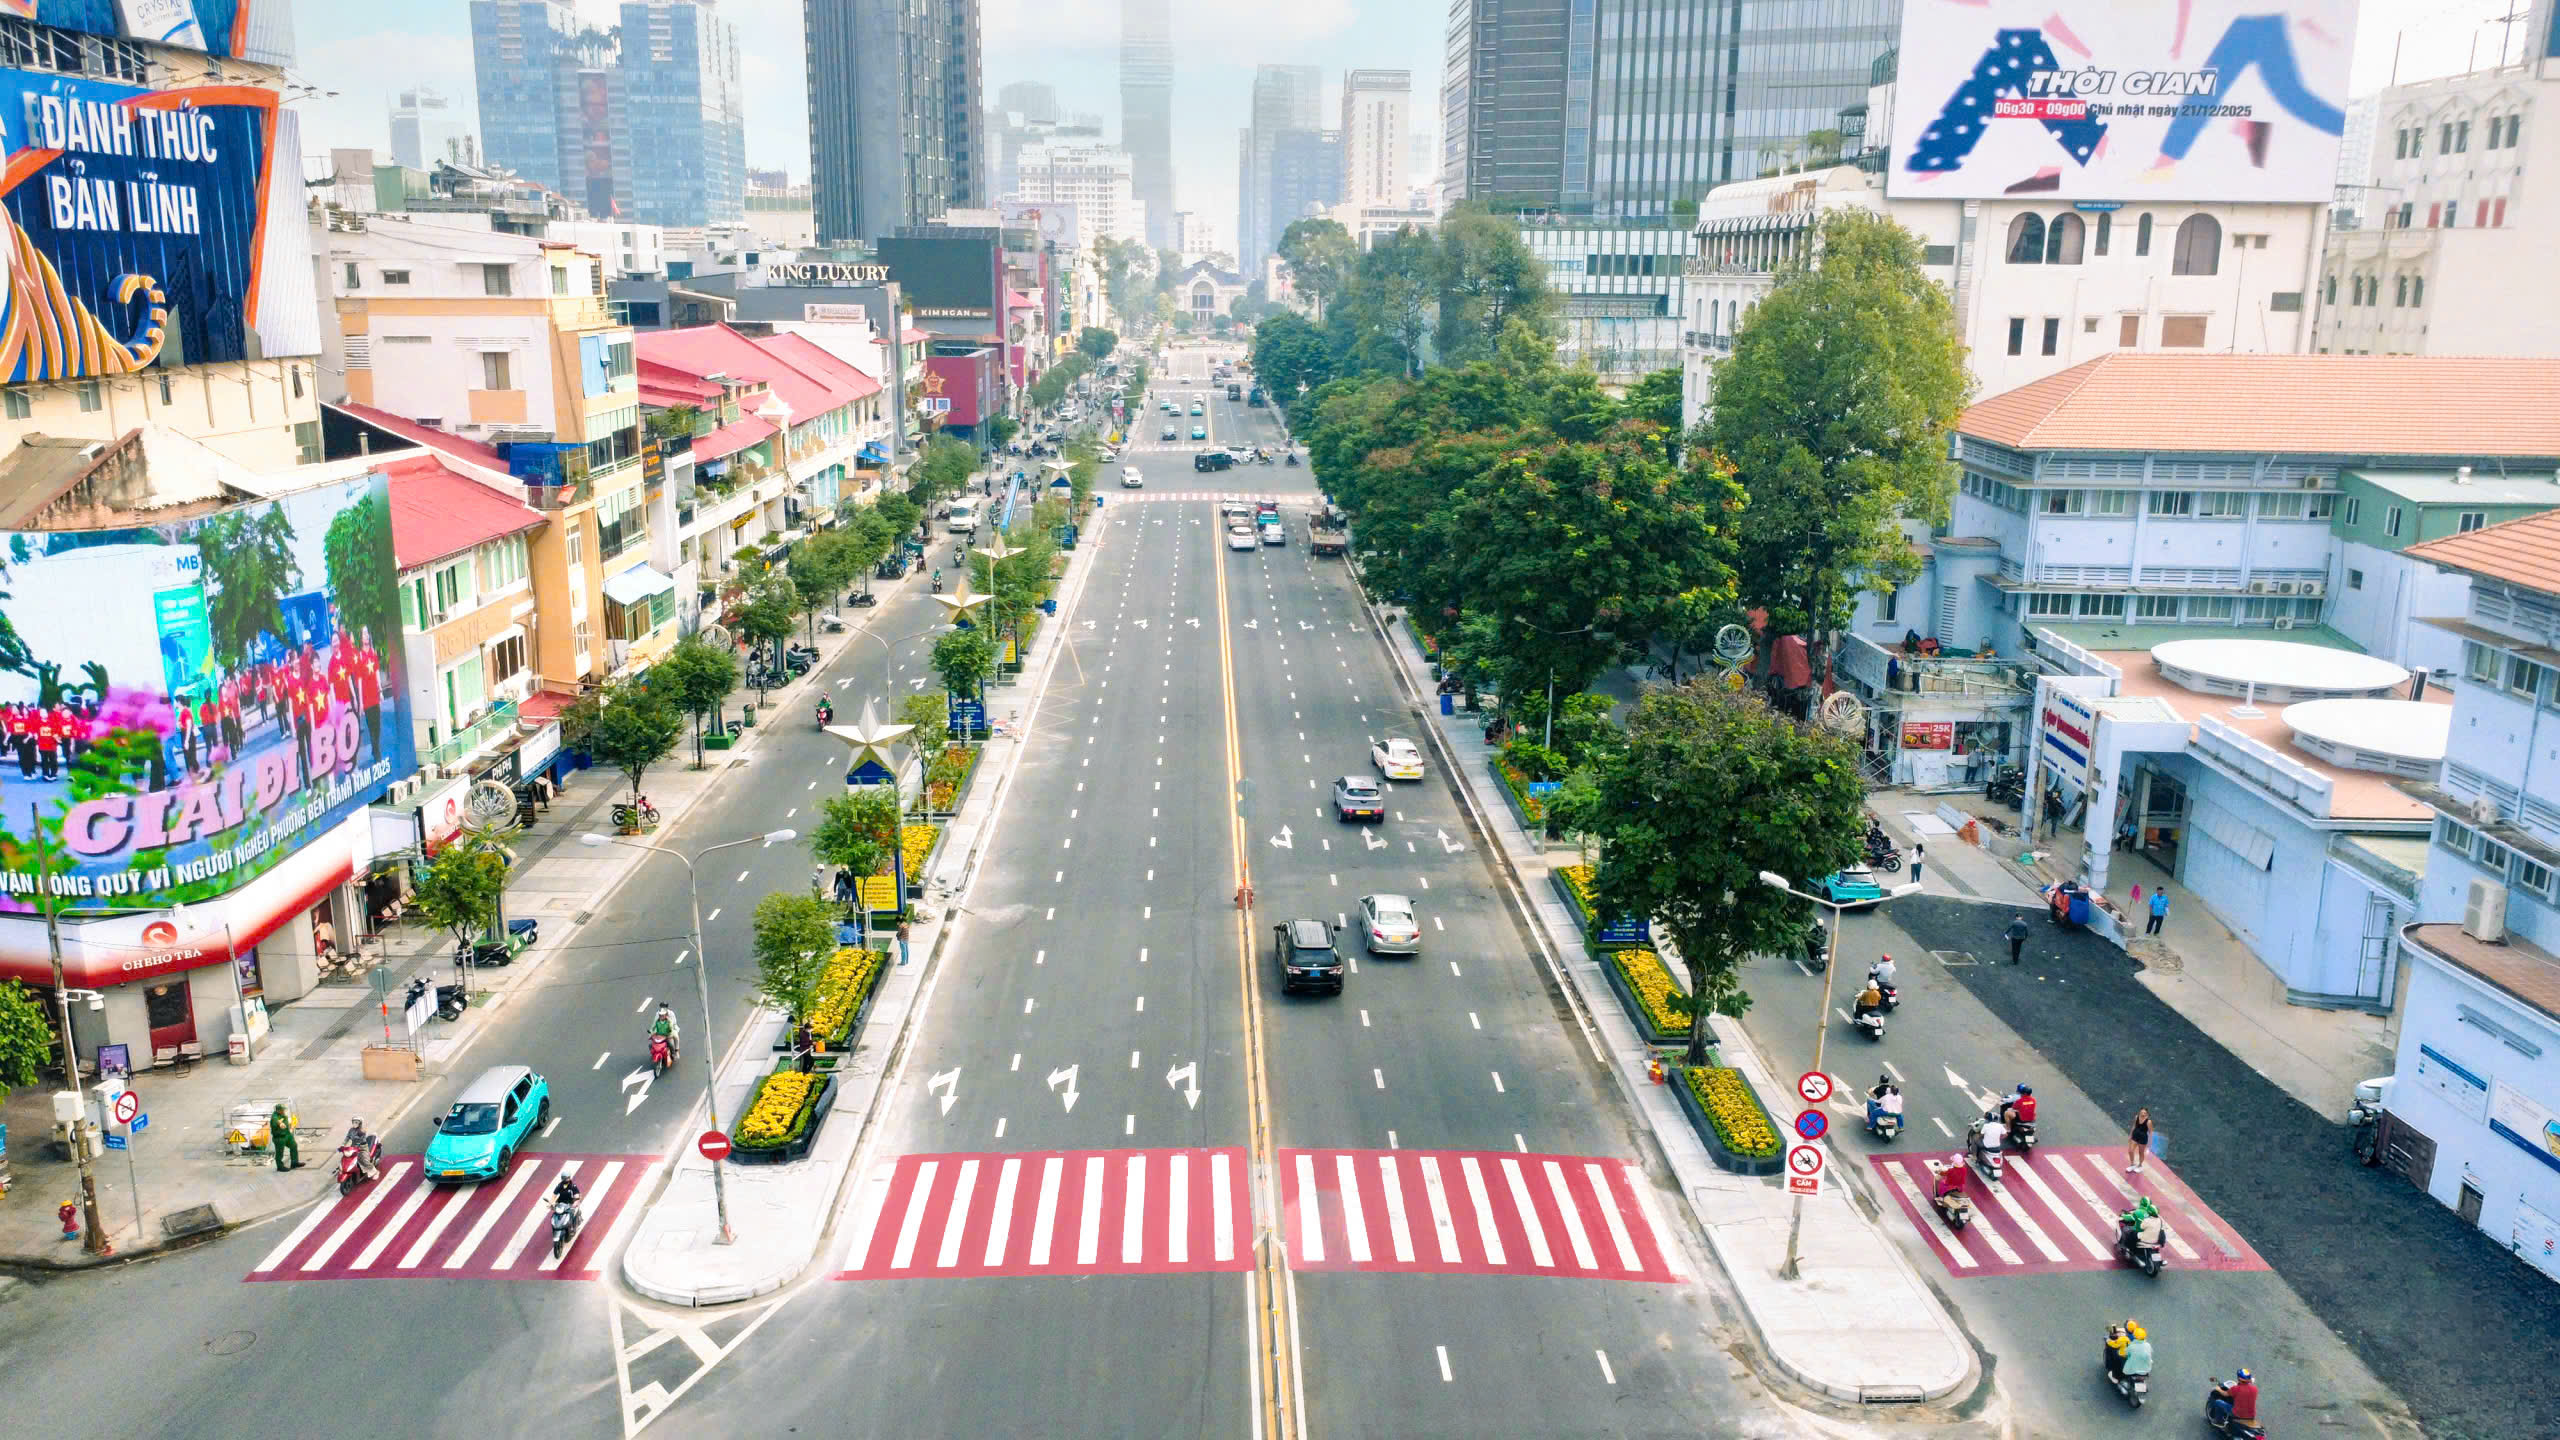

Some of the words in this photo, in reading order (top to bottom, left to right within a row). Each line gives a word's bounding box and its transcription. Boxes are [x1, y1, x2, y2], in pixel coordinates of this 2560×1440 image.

[2031, 65, 2117, 96] THỜI
[2122, 70, 2217, 97] GIAN
[41, 80, 133, 156] ĐÁNH
[137, 97, 217, 163] THỨC
[1994, 101, 2035, 116] 06g30
[2046, 102, 2086, 117] 09g00
[2089, 102, 2114, 116] Chủ
[2116, 104, 2145, 118] nhật
[2147, 104, 2179, 118] ngày
[2181, 104, 2253, 117] 21/12/2025
[50, 160, 120, 231] BẢN
[130, 171, 200, 234] LĨNH
[766, 264, 811, 280] KING
[816, 264, 889, 281] LUXURY
[921, 309, 940, 317] KIM
[942, 309, 970, 317] NGAN
[63, 766, 245, 858] GIẢI
[256, 739, 301, 812] ĐI
[309, 705, 361, 781] BỘ
[148, 863, 172, 890] VÌ
[176, 848, 233, 885] NGƯỜI
[271, 810, 307, 845] PHƯỜNG
[372, 756, 391, 781] 2025
[174, 948, 203, 962] TEA
